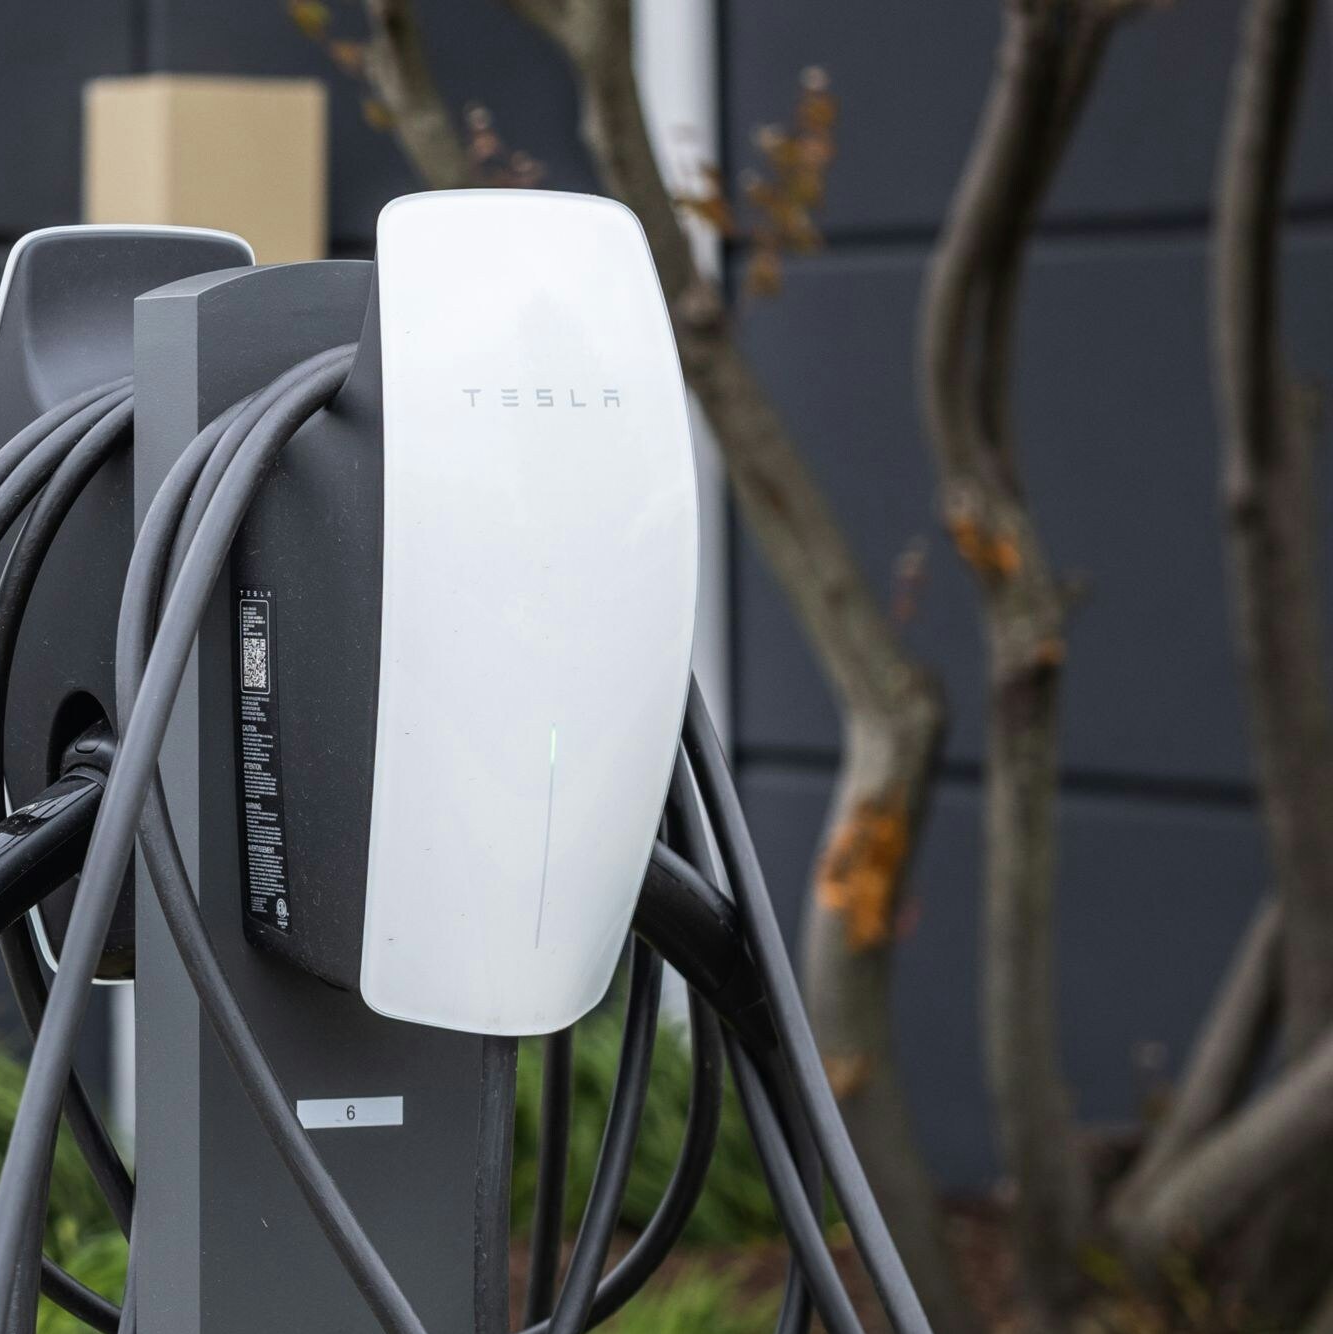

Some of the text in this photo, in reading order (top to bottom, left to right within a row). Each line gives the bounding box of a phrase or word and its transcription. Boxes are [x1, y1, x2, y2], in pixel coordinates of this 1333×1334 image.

[462, 388, 620, 407] TESLA
[240, 590, 272, 598] TESLA
[346, 1104, 356, 1121] 6
